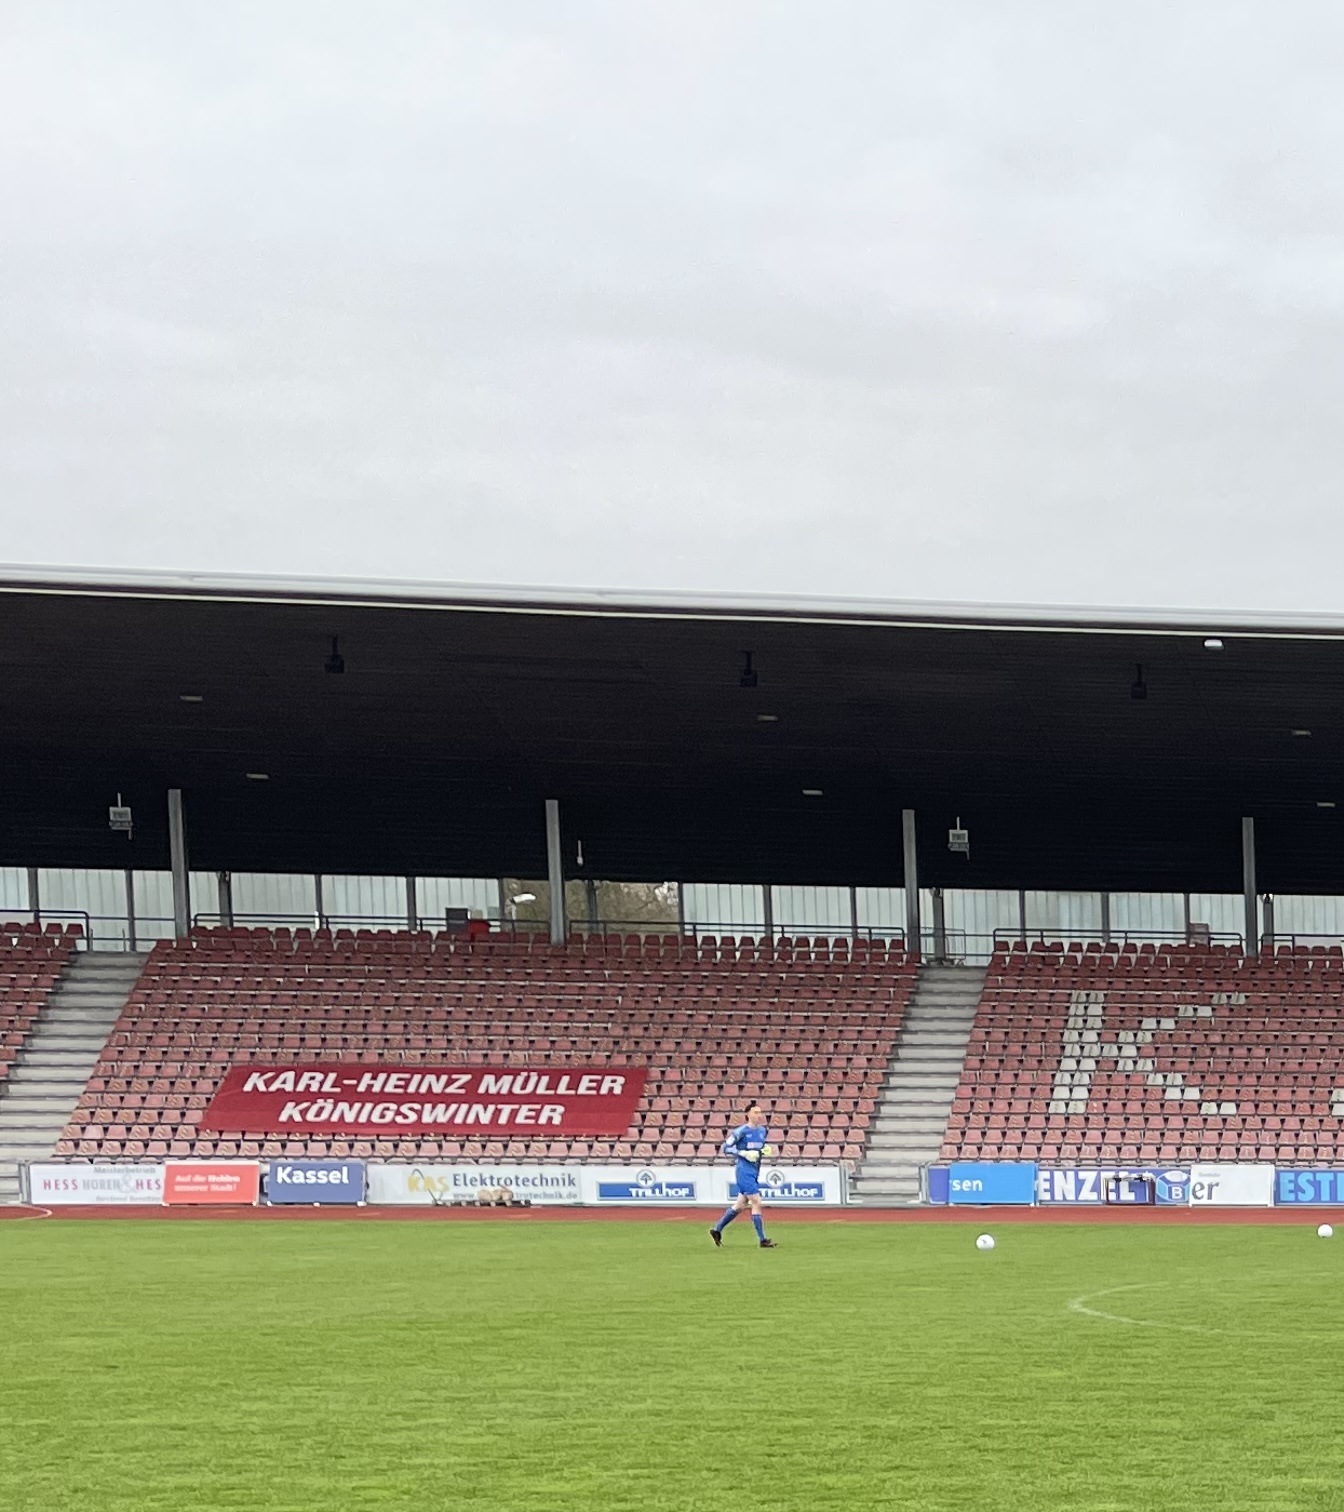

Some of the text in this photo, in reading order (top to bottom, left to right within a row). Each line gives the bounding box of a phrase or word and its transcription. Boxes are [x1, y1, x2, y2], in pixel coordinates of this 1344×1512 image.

[243, 1071, 626, 1095] KARL-HEINZ MÜLLER
[279, 1099, 566, 1126] KÖNIGSWINTER
[276, 1166, 350, 1184] Kassel
[452, 1173, 577, 1188] Elektrotechnik
[43, 1178, 78, 1190] HESS
[949, 1179, 983, 1192] sen
